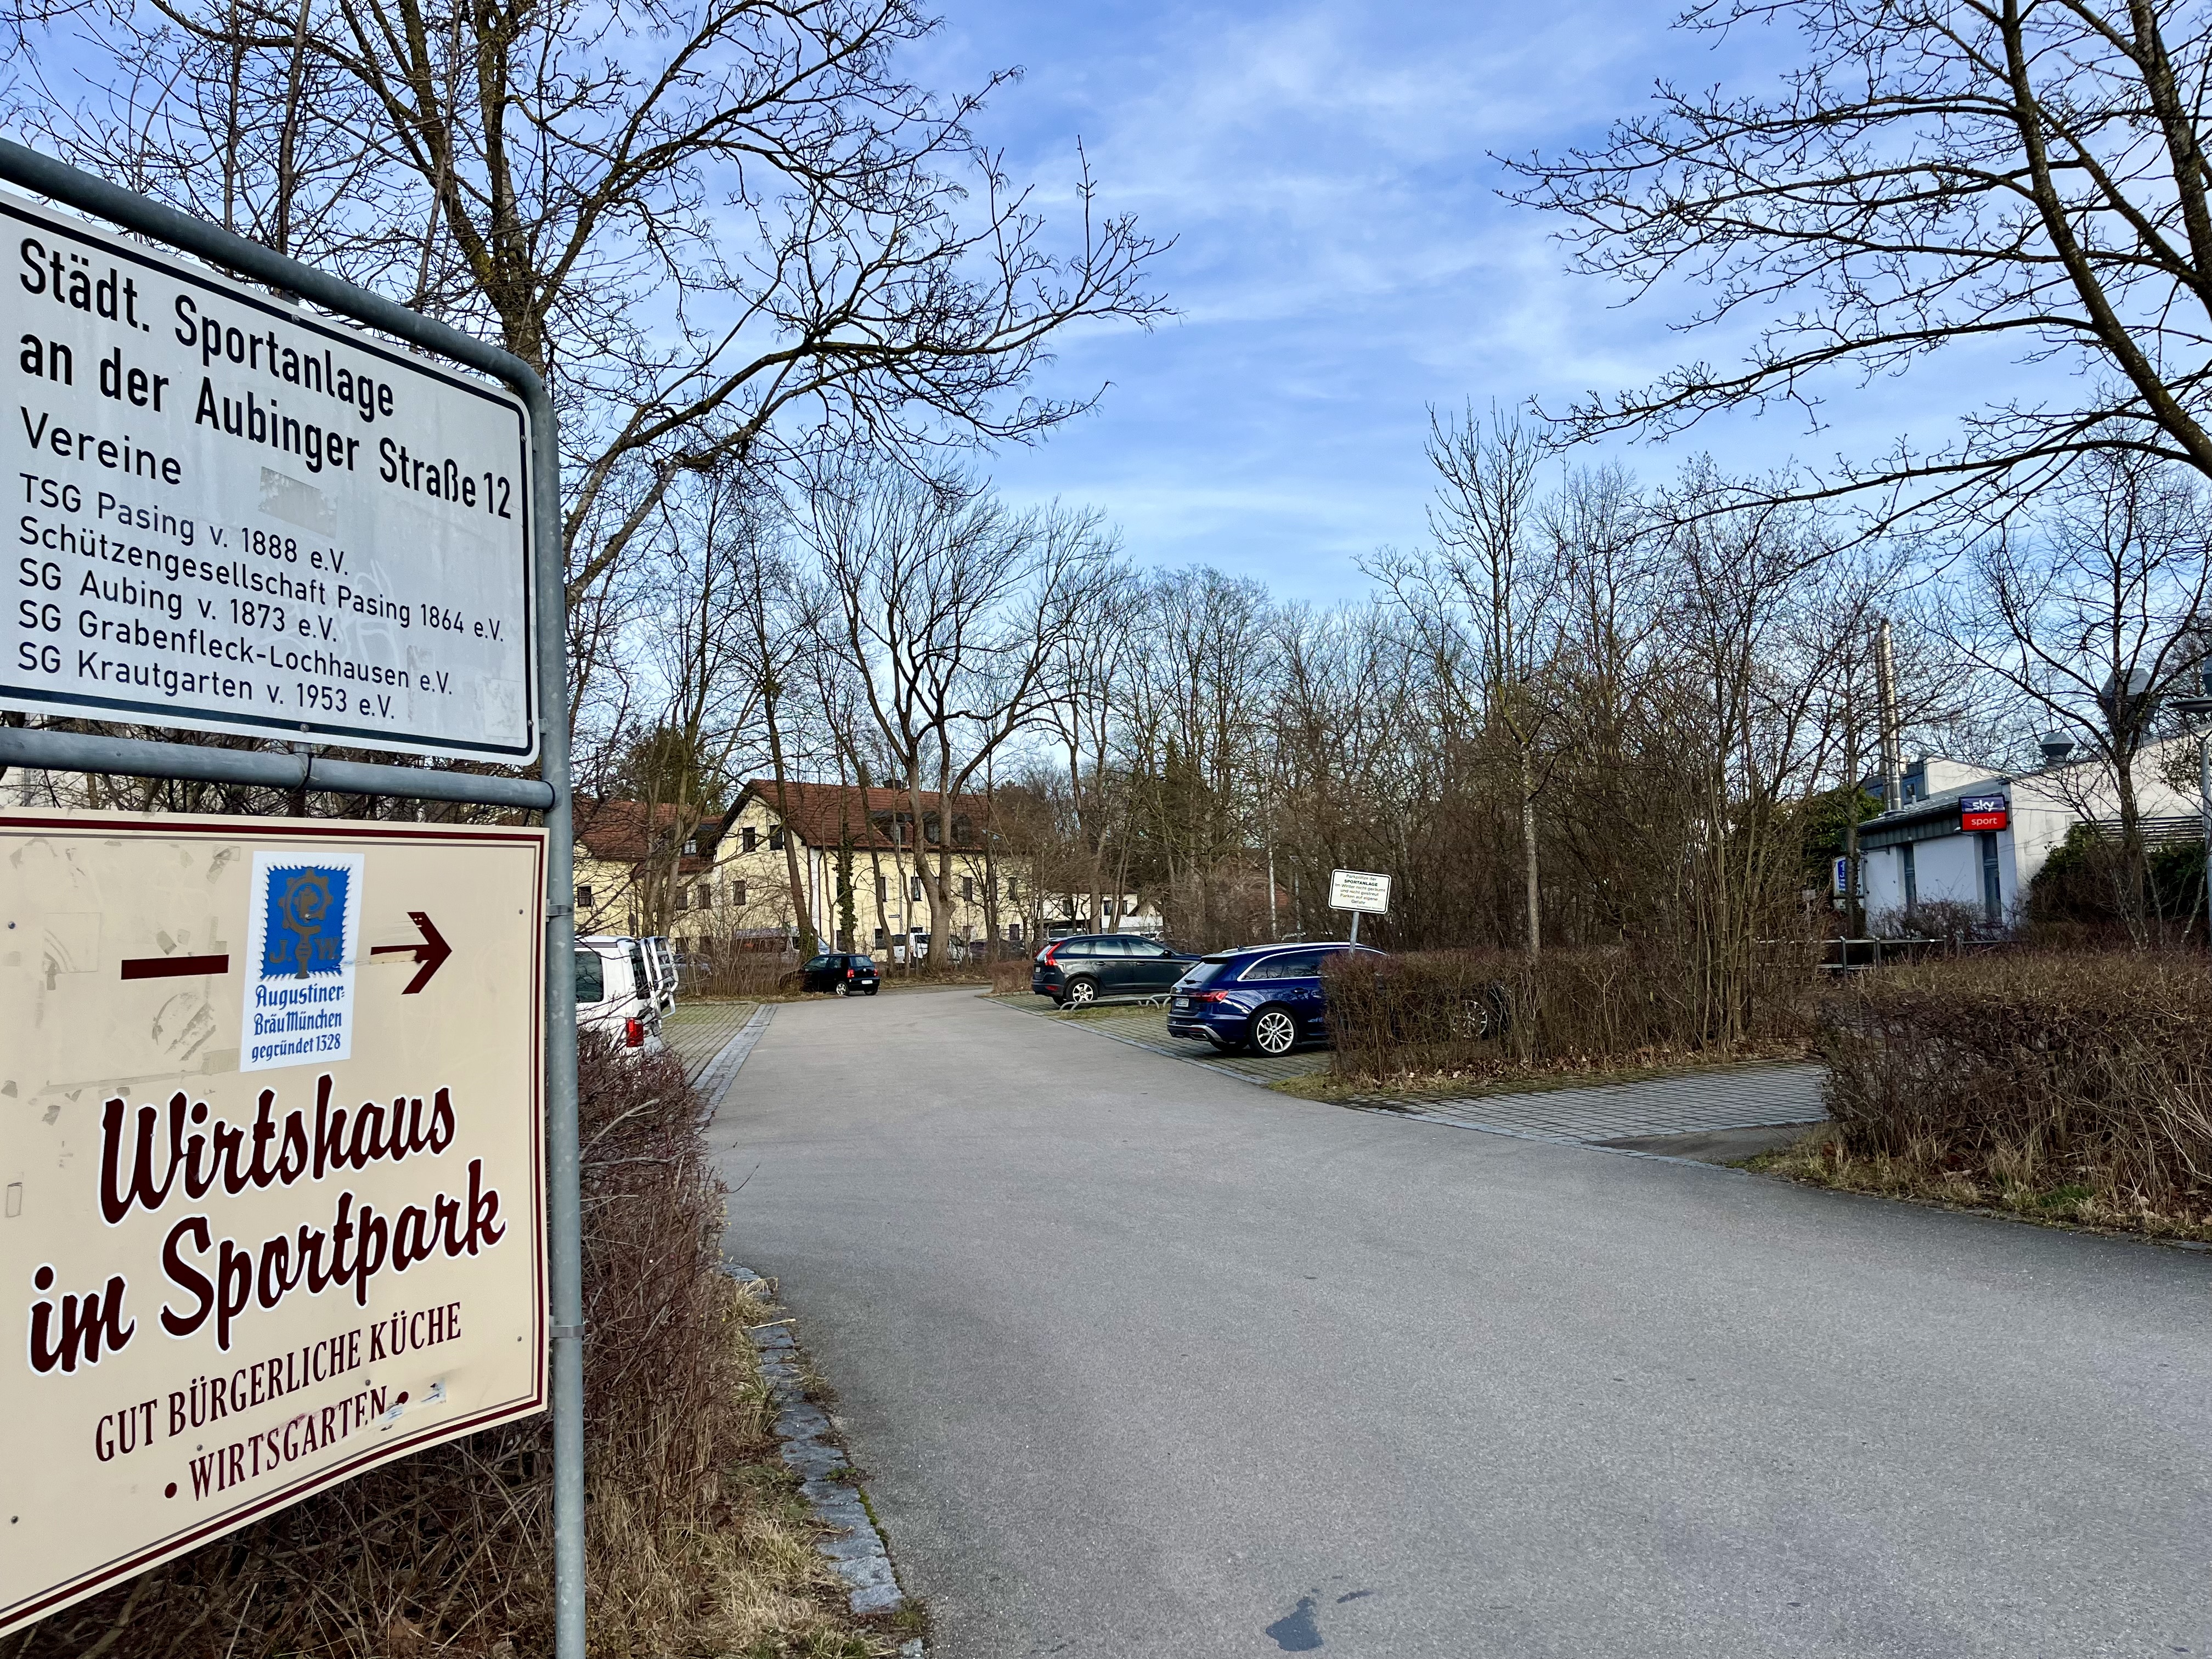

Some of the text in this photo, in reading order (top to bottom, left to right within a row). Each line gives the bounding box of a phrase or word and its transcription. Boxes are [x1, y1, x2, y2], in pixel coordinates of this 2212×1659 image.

[19, 238, 394, 422] Städt. Sportanlage
[20, 405, 181, 485] Vereine
[21, 334, 511, 519] an der Aubinger Straße 12
[19, 472, 348, 575] TSG Pasing v. 1888 e.V.
[19, 516, 504, 642] Schützengesellschaft Pasing 1864 e.V.
[19, 558, 337, 642] SG Aubing v. 1873 e.V.
[18, 599, 452, 695] SG Grabenfleck-Lochhausen e.V.
[18, 642, 394, 718] SG Krautgarten v. 1953 e.V.
[1971, 817, 1997, 826] sport
[1972, 799, 1994, 812] sky
[252, 1034, 341, 1063] gegründet 1328
[254, 1008, 342, 1035] Bräu München
[101, 1074, 454, 1224] Wirtshaus
[30, 1159, 506, 1373] im Sportpark
[95, 1302, 461, 1462] GUT BÜRGERLICHE KÜCHE
[189, 1386, 387, 1502] WIRTSGARTEN
